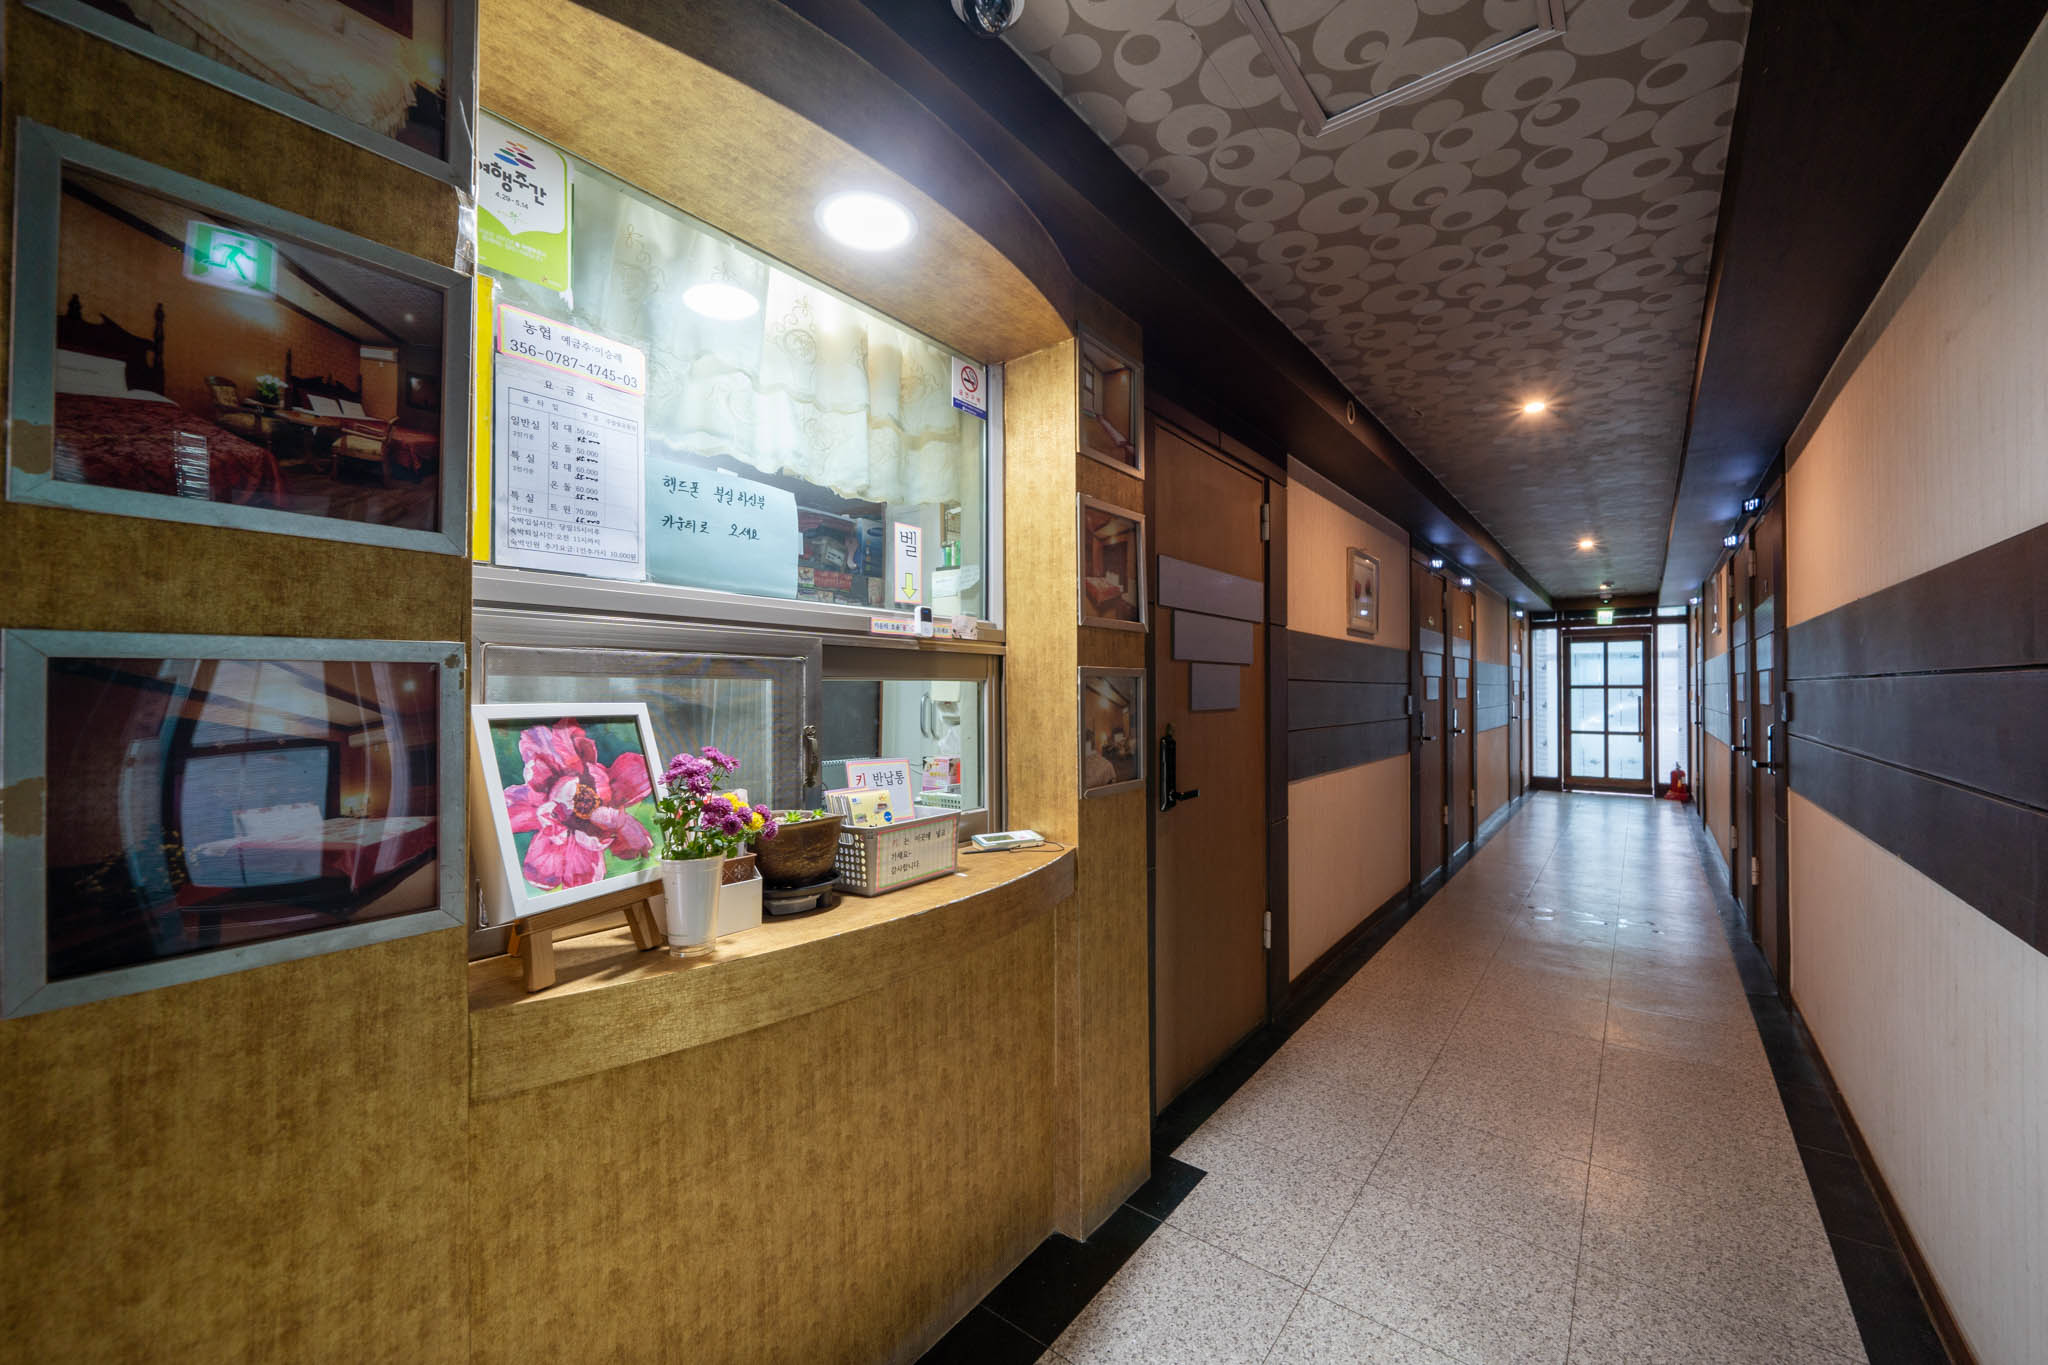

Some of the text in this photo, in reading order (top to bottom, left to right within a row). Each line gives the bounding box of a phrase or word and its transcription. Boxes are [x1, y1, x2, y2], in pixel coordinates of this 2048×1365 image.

[522, 319, 552, 341] 농협
[509, 338, 638, 388] 356-0787-4745-03
[510, 415, 541, 431] 일반실
[1744, 498, 1760, 511] 101
[728, 523, 760, 540] 오세요
[900, 531, 917, 558] 벨
[855, 770, 905, 787] 키 반납통
